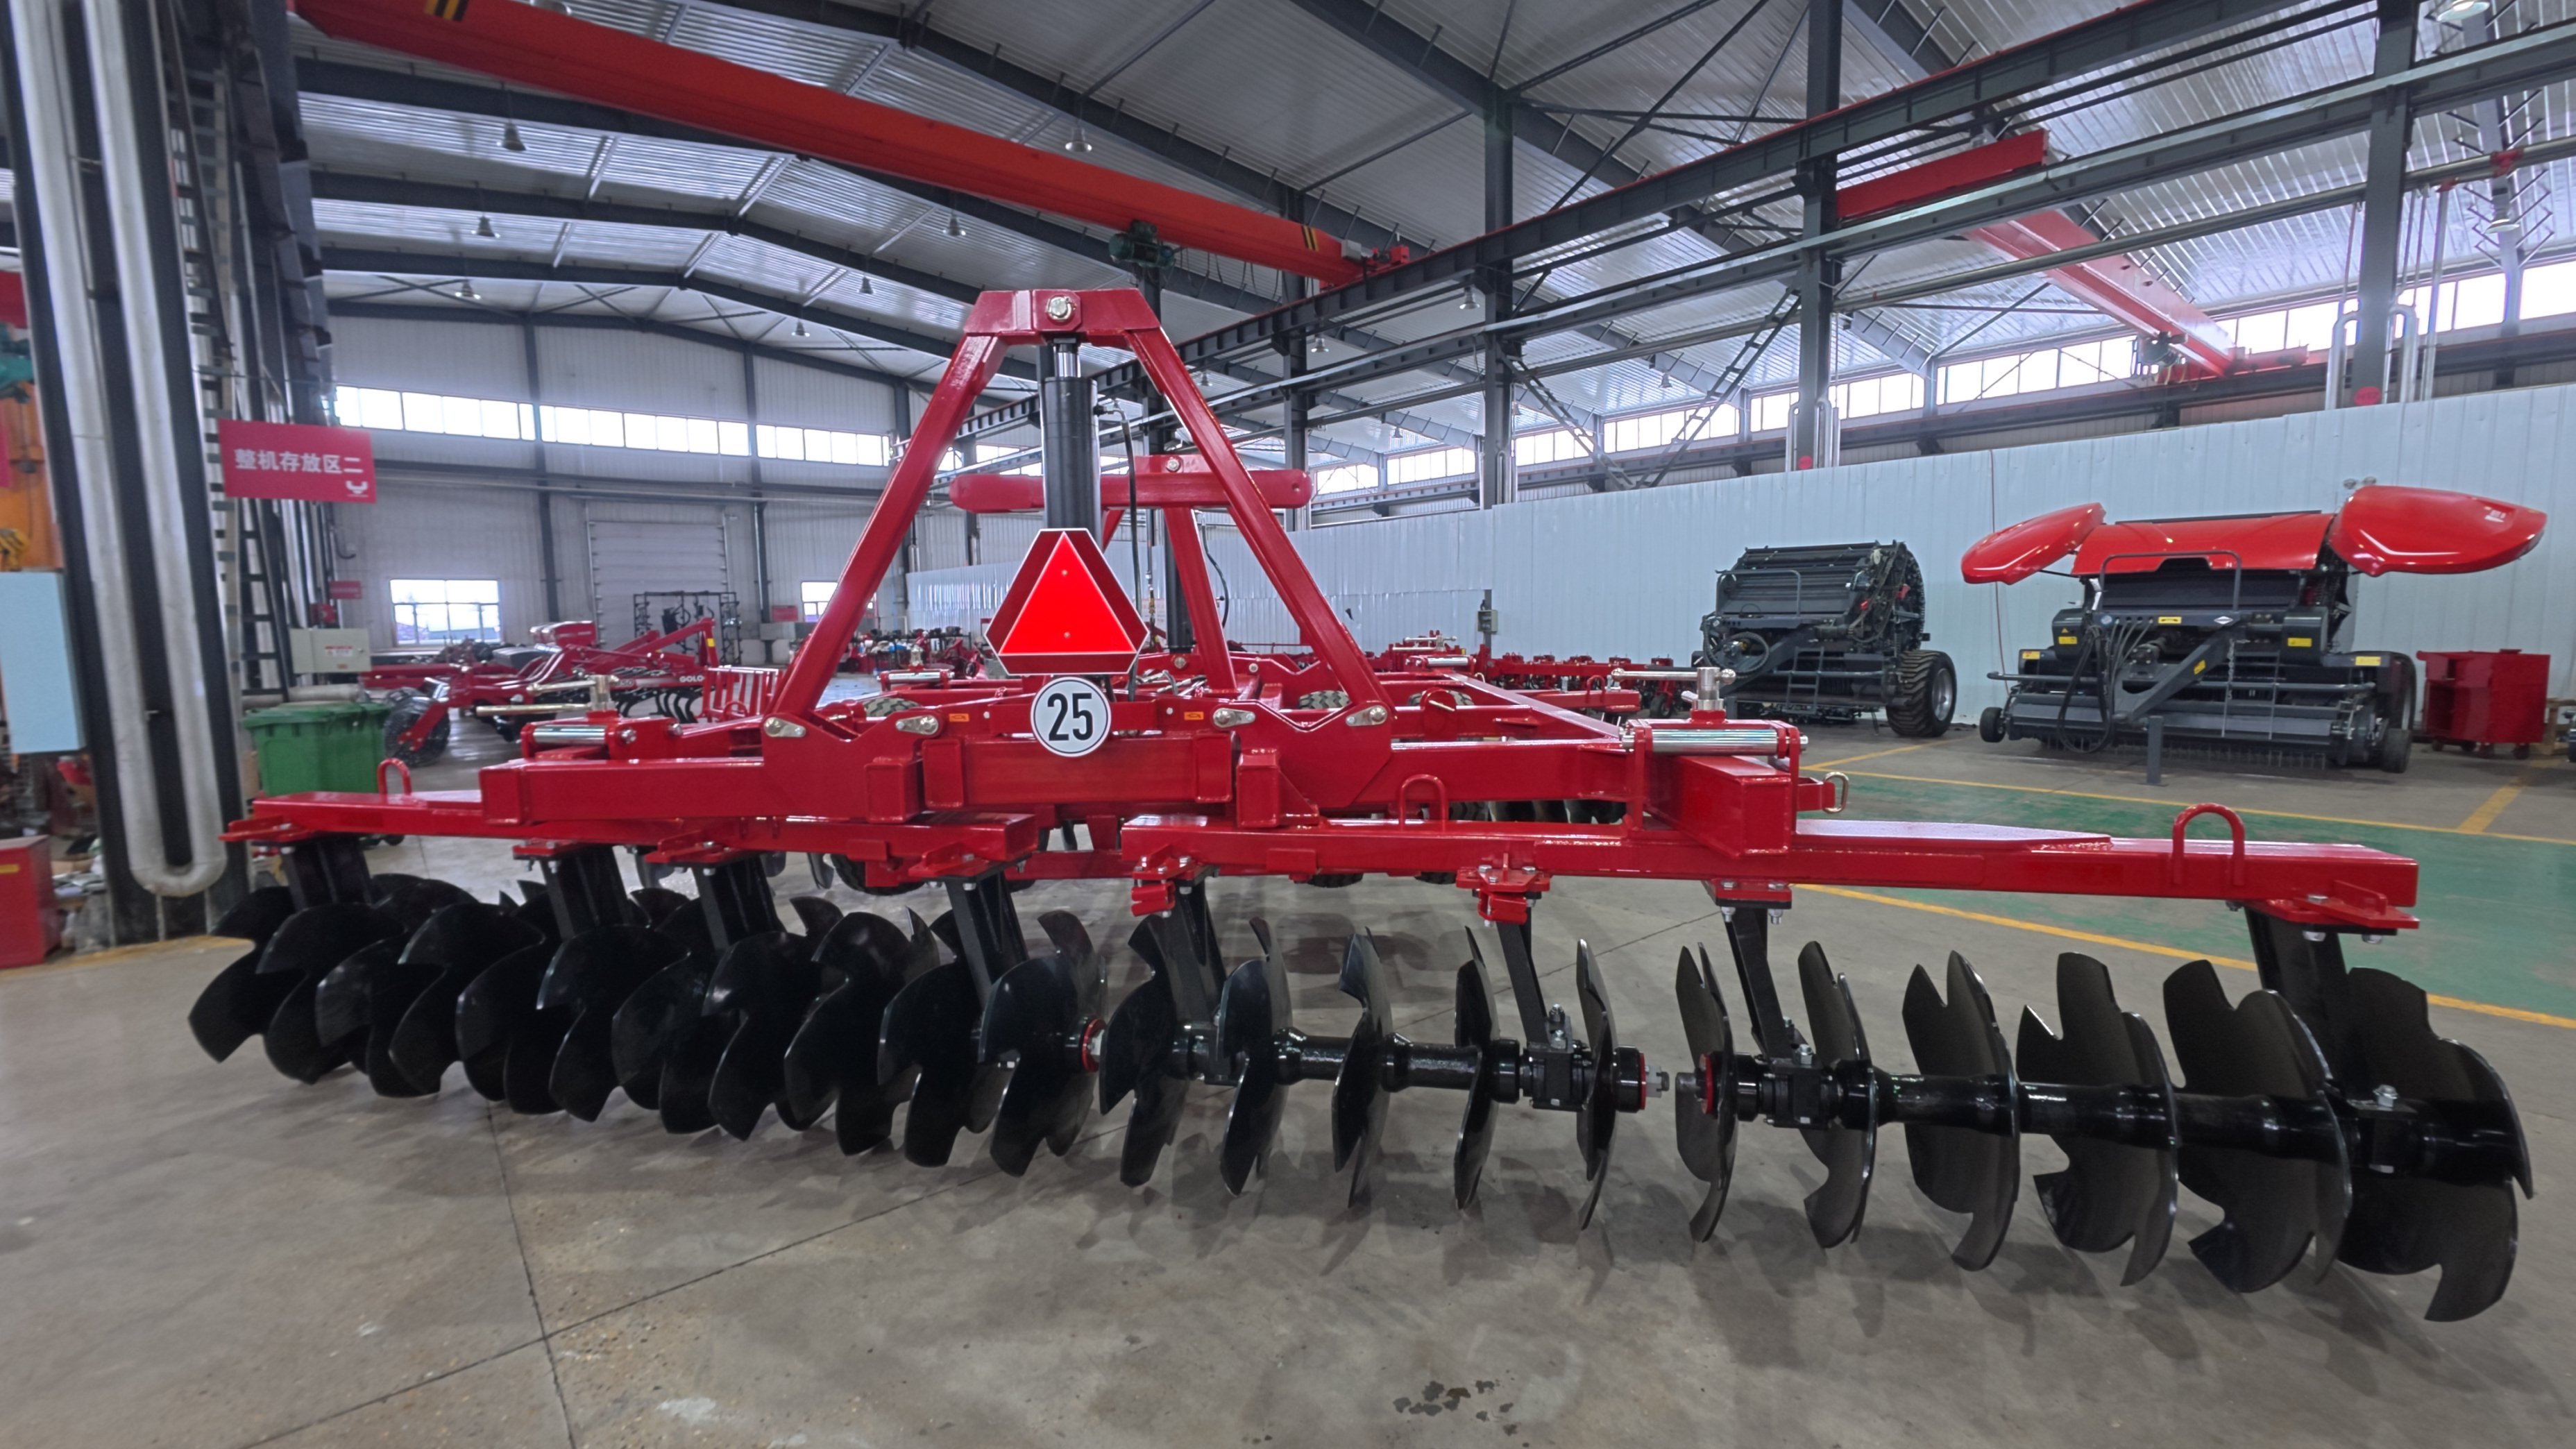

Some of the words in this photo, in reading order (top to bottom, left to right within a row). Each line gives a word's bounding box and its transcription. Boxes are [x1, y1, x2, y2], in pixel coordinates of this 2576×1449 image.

[235, 449, 364, 474] 整机存放区二
[1047, 693, 1093, 740] 25
